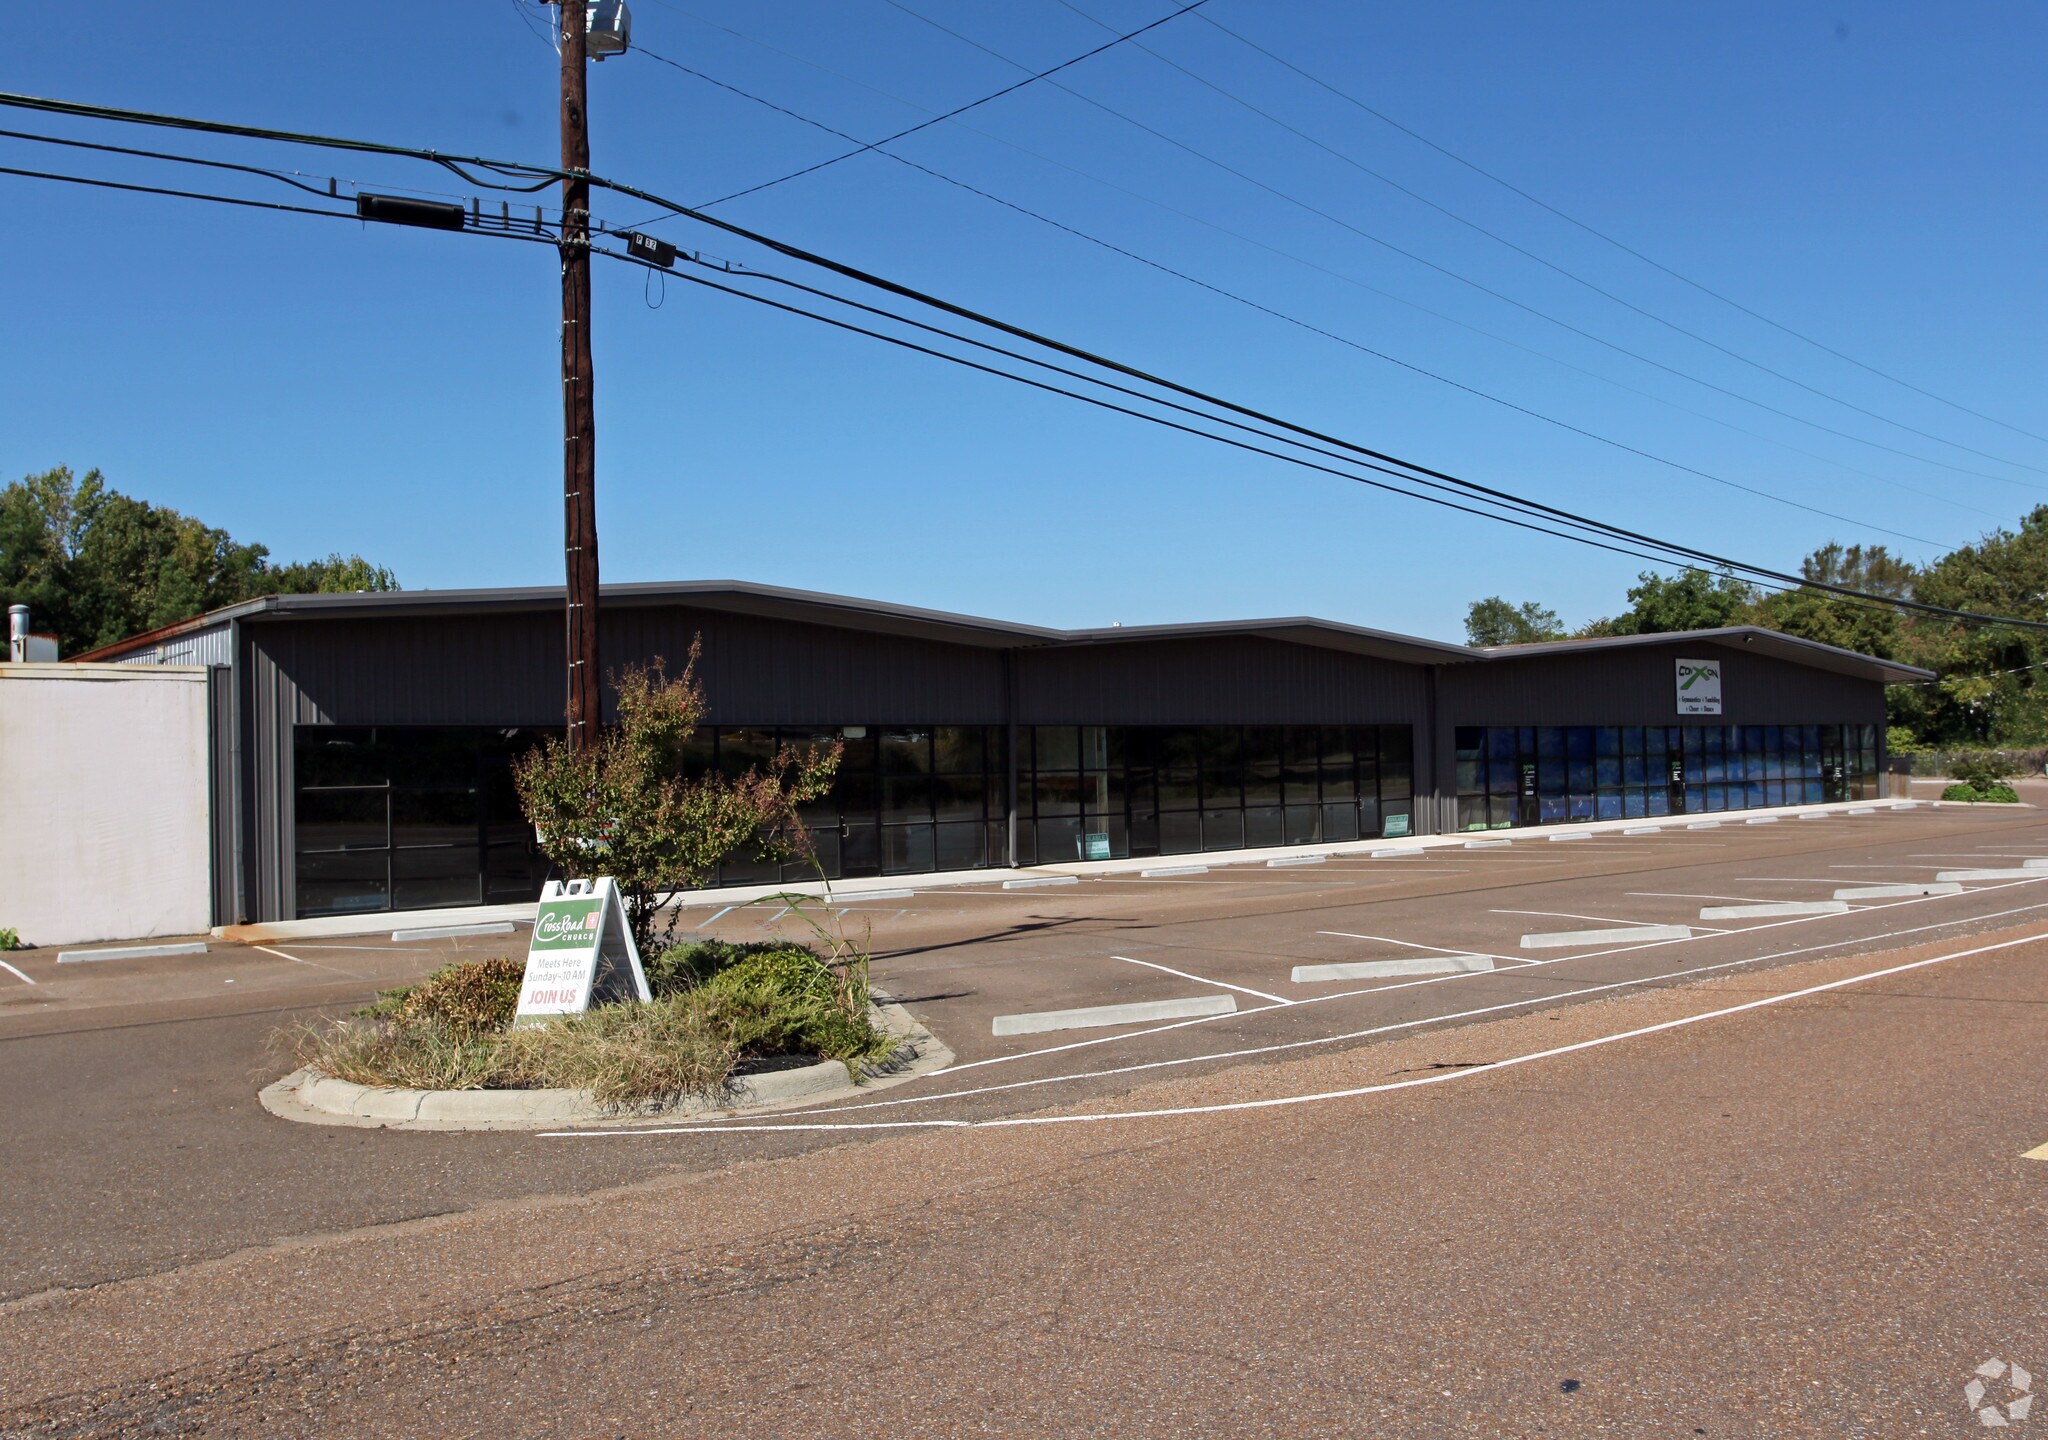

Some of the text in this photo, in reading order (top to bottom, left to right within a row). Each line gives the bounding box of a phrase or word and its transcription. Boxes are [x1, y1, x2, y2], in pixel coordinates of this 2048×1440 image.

[637, 235, 656, 249] P 32
[536, 912, 585, 942] CrossRoad
[562, 933, 594, 941] CHURCH
[537, 958, 581, 969] Meets Here
[572, 970, 585, 980] AM
[528, 989, 576, 1004] JOIN US
